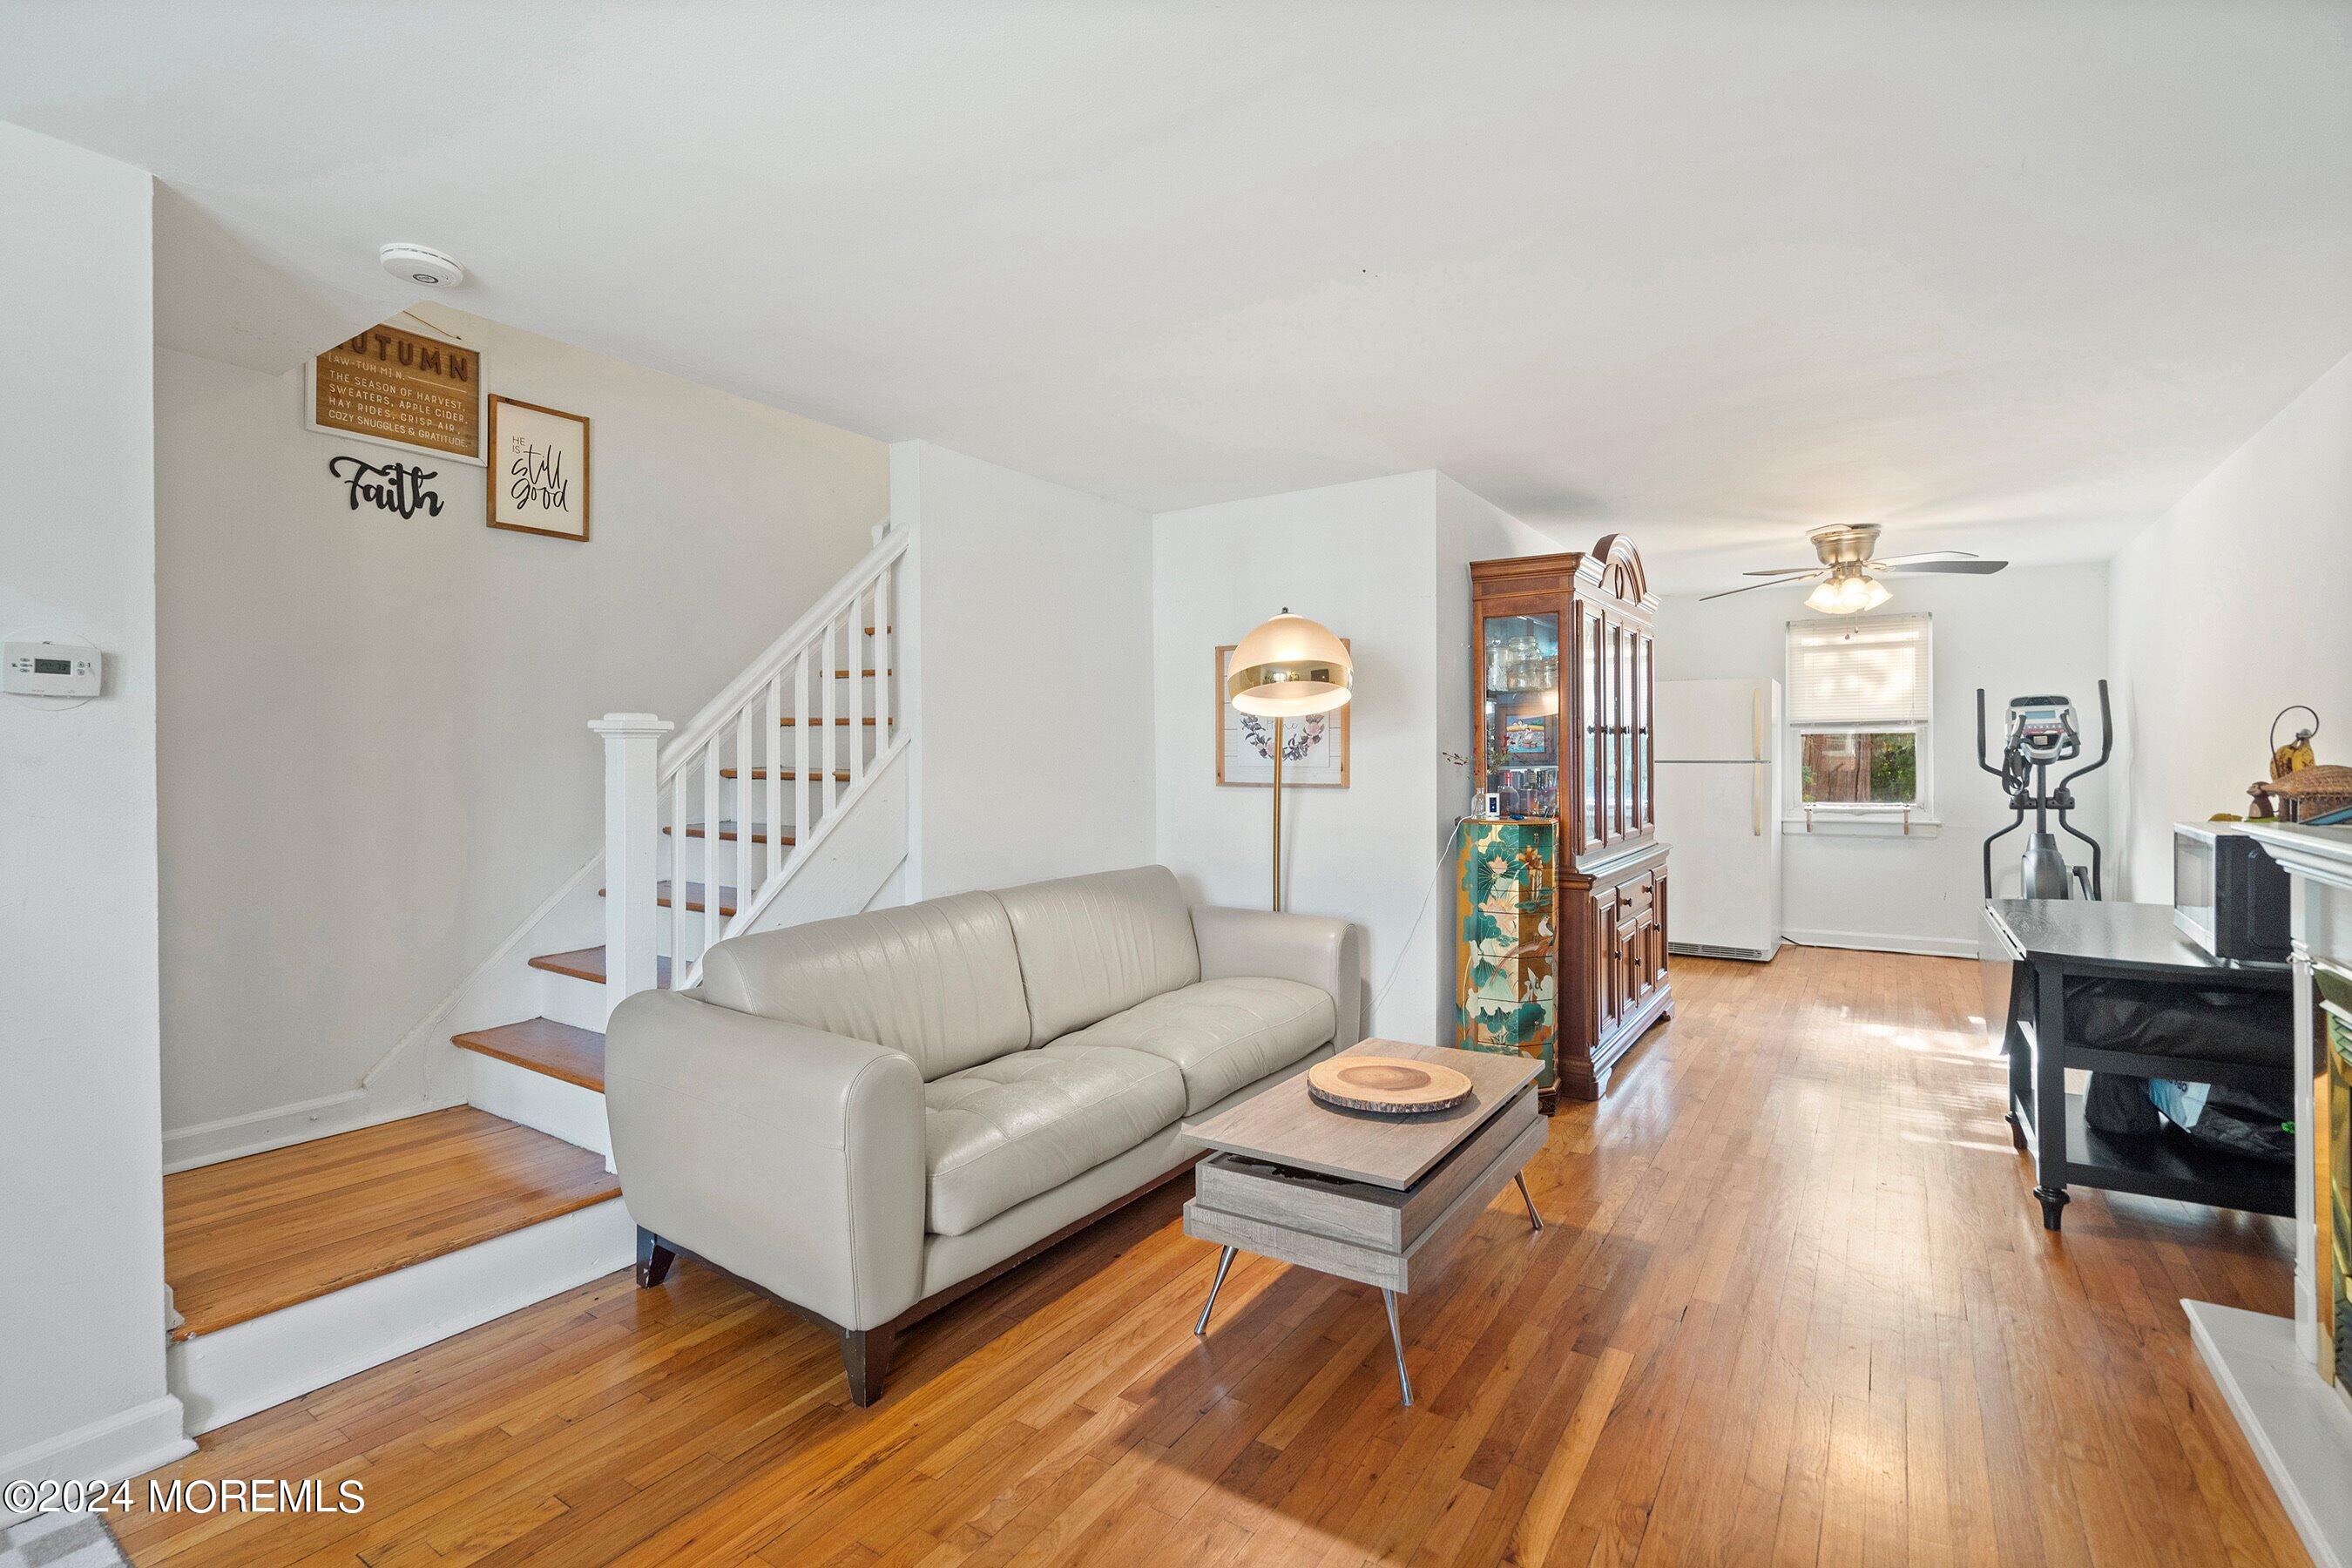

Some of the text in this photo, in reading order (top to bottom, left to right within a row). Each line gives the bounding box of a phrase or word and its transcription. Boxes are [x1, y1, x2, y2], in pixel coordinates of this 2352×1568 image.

[336, 332, 468, 382] UTUMN
[328, 383, 394, 407] SWEATERS,
[399, 400, 430, 415] APPLE
[329, 370, 465, 412] THE SEASON OF HARVEST,
[328, 396, 351, 409] HAY
[357, 402, 395, 420] RIDES,
[400, 413, 432, 427] CRISP
[328, 409, 468, 448] COZY SNUGGLES & GRATITUDE.
[512, 436, 525, 446] HE
[512, 444, 521, 454] IS
[511, 444, 562, 489] still
[329, 456, 444, 520] Faith
[511, 477, 569, 512] good
